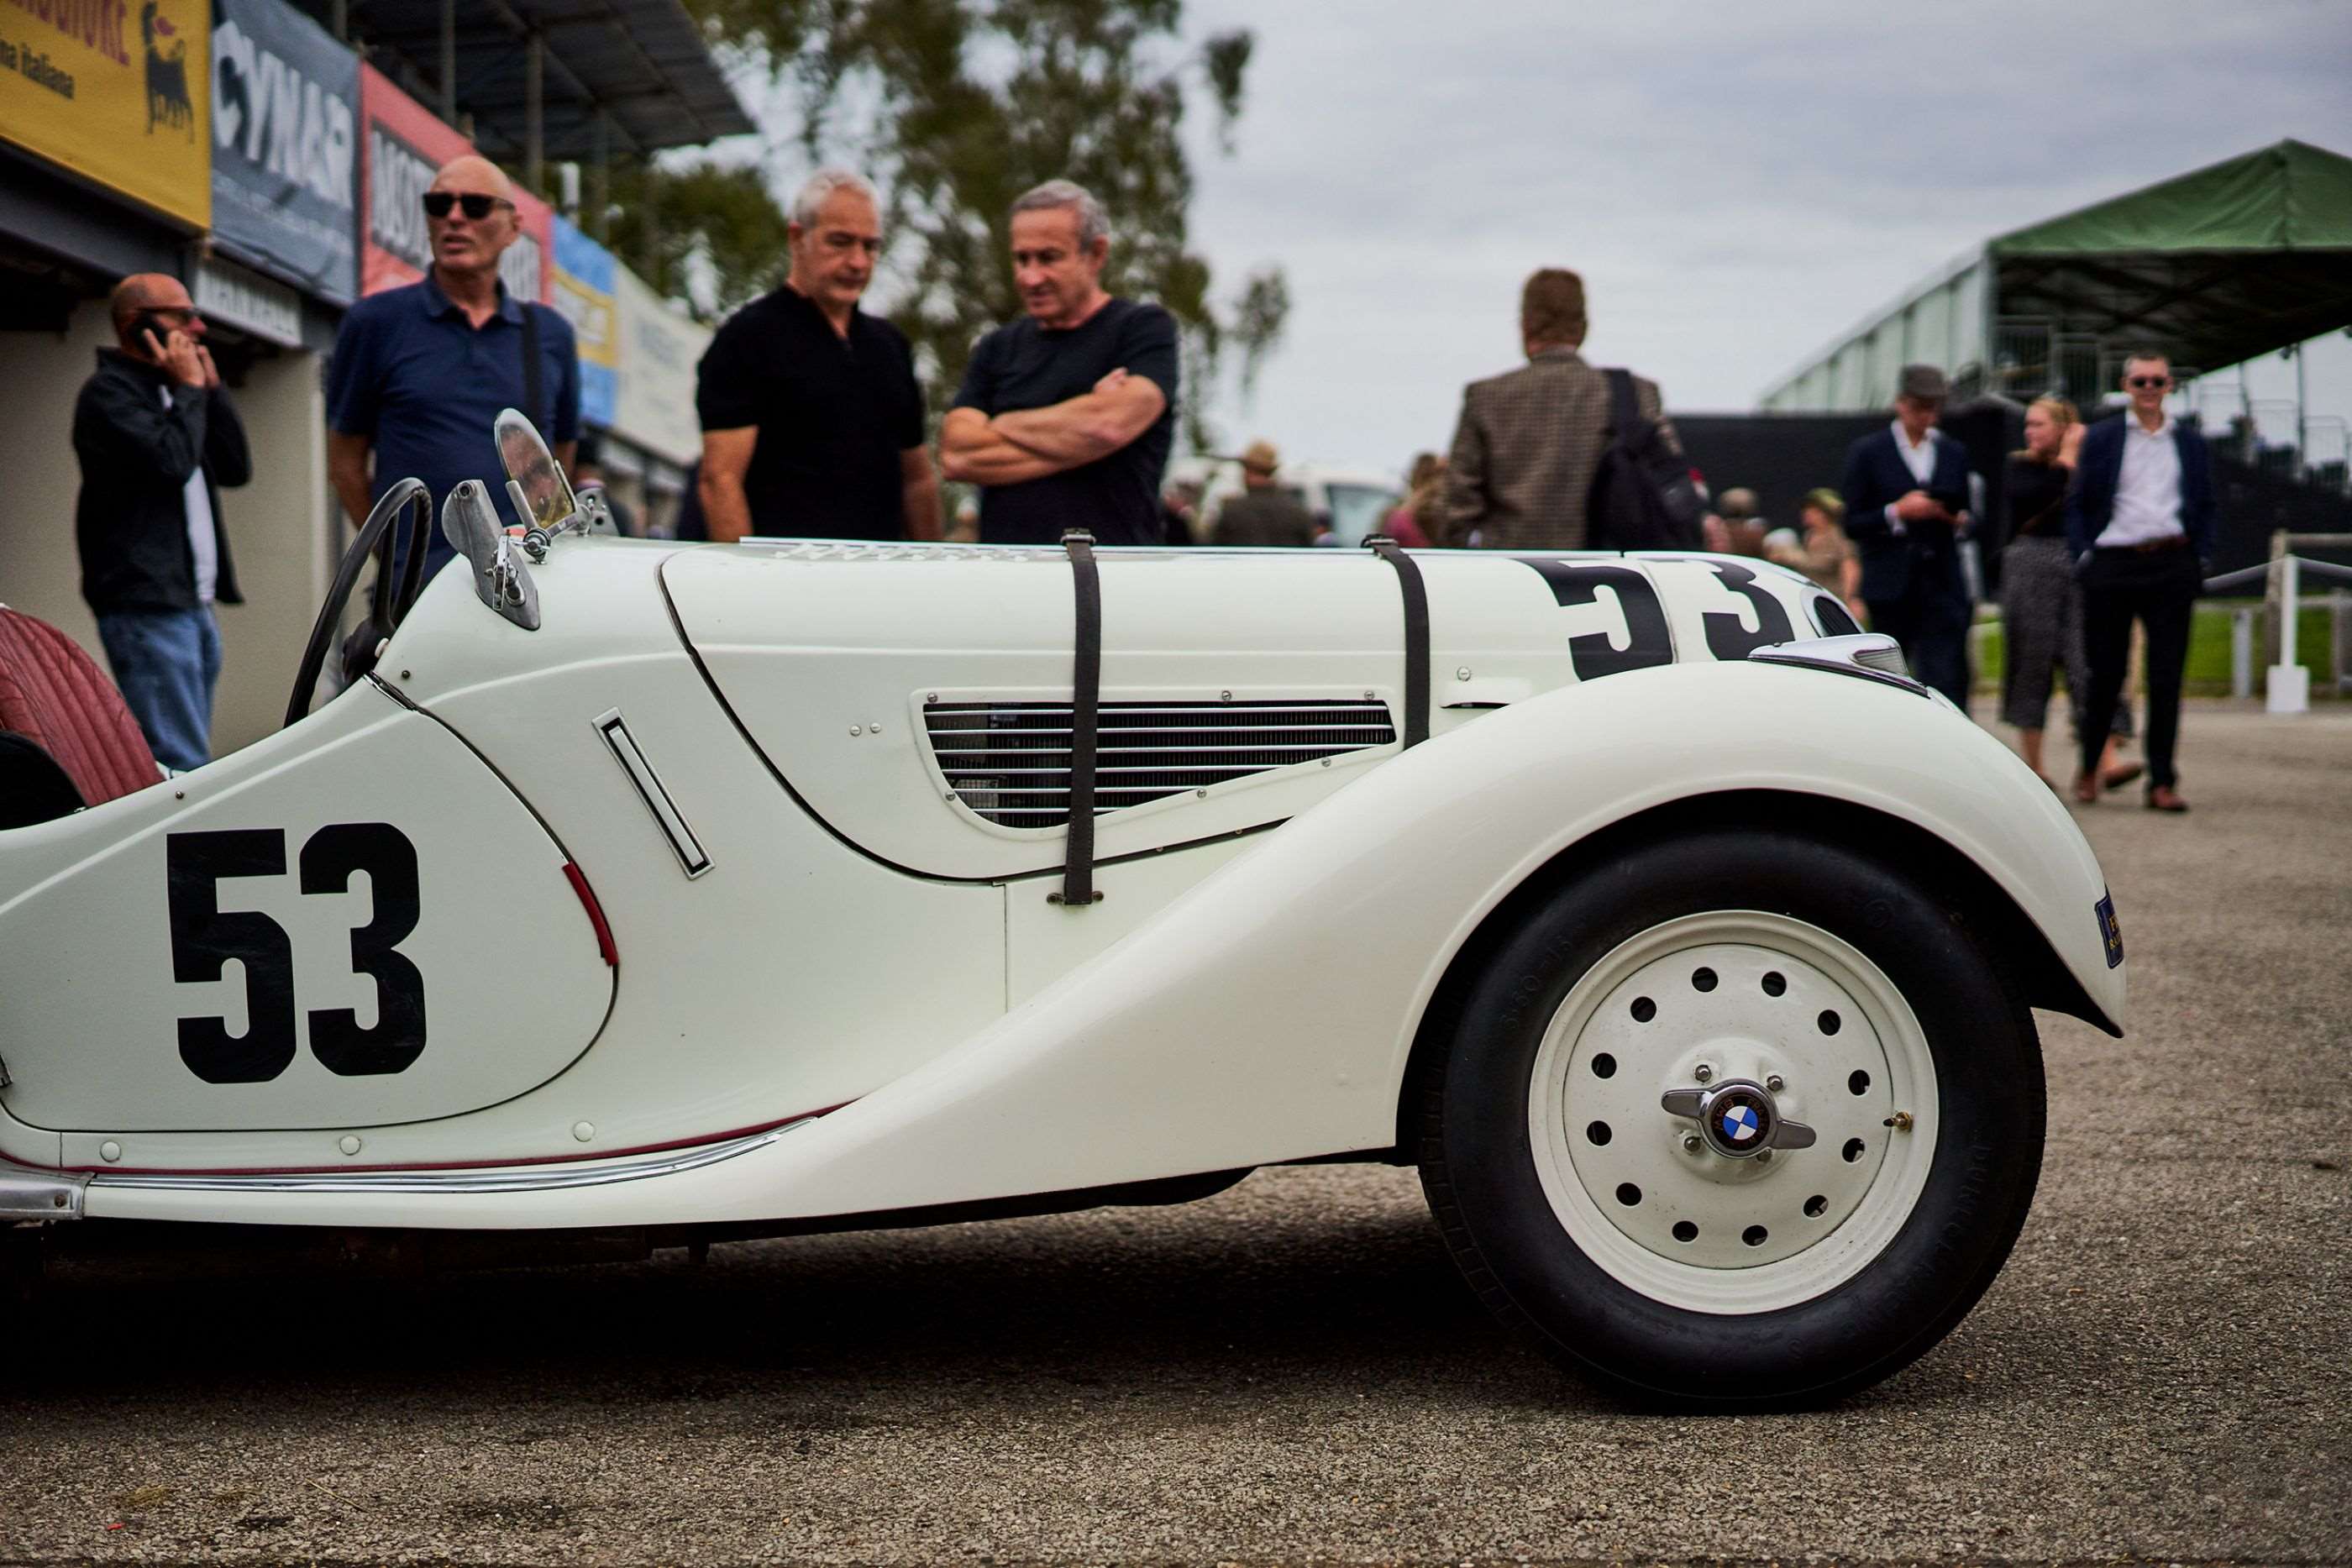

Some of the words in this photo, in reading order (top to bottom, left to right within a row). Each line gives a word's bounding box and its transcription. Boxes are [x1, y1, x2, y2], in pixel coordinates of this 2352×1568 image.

[212, 20, 353, 212] CYNAR
[1509, 558, 1796, 682] 53
[166, 822, 427, 1084] 53
